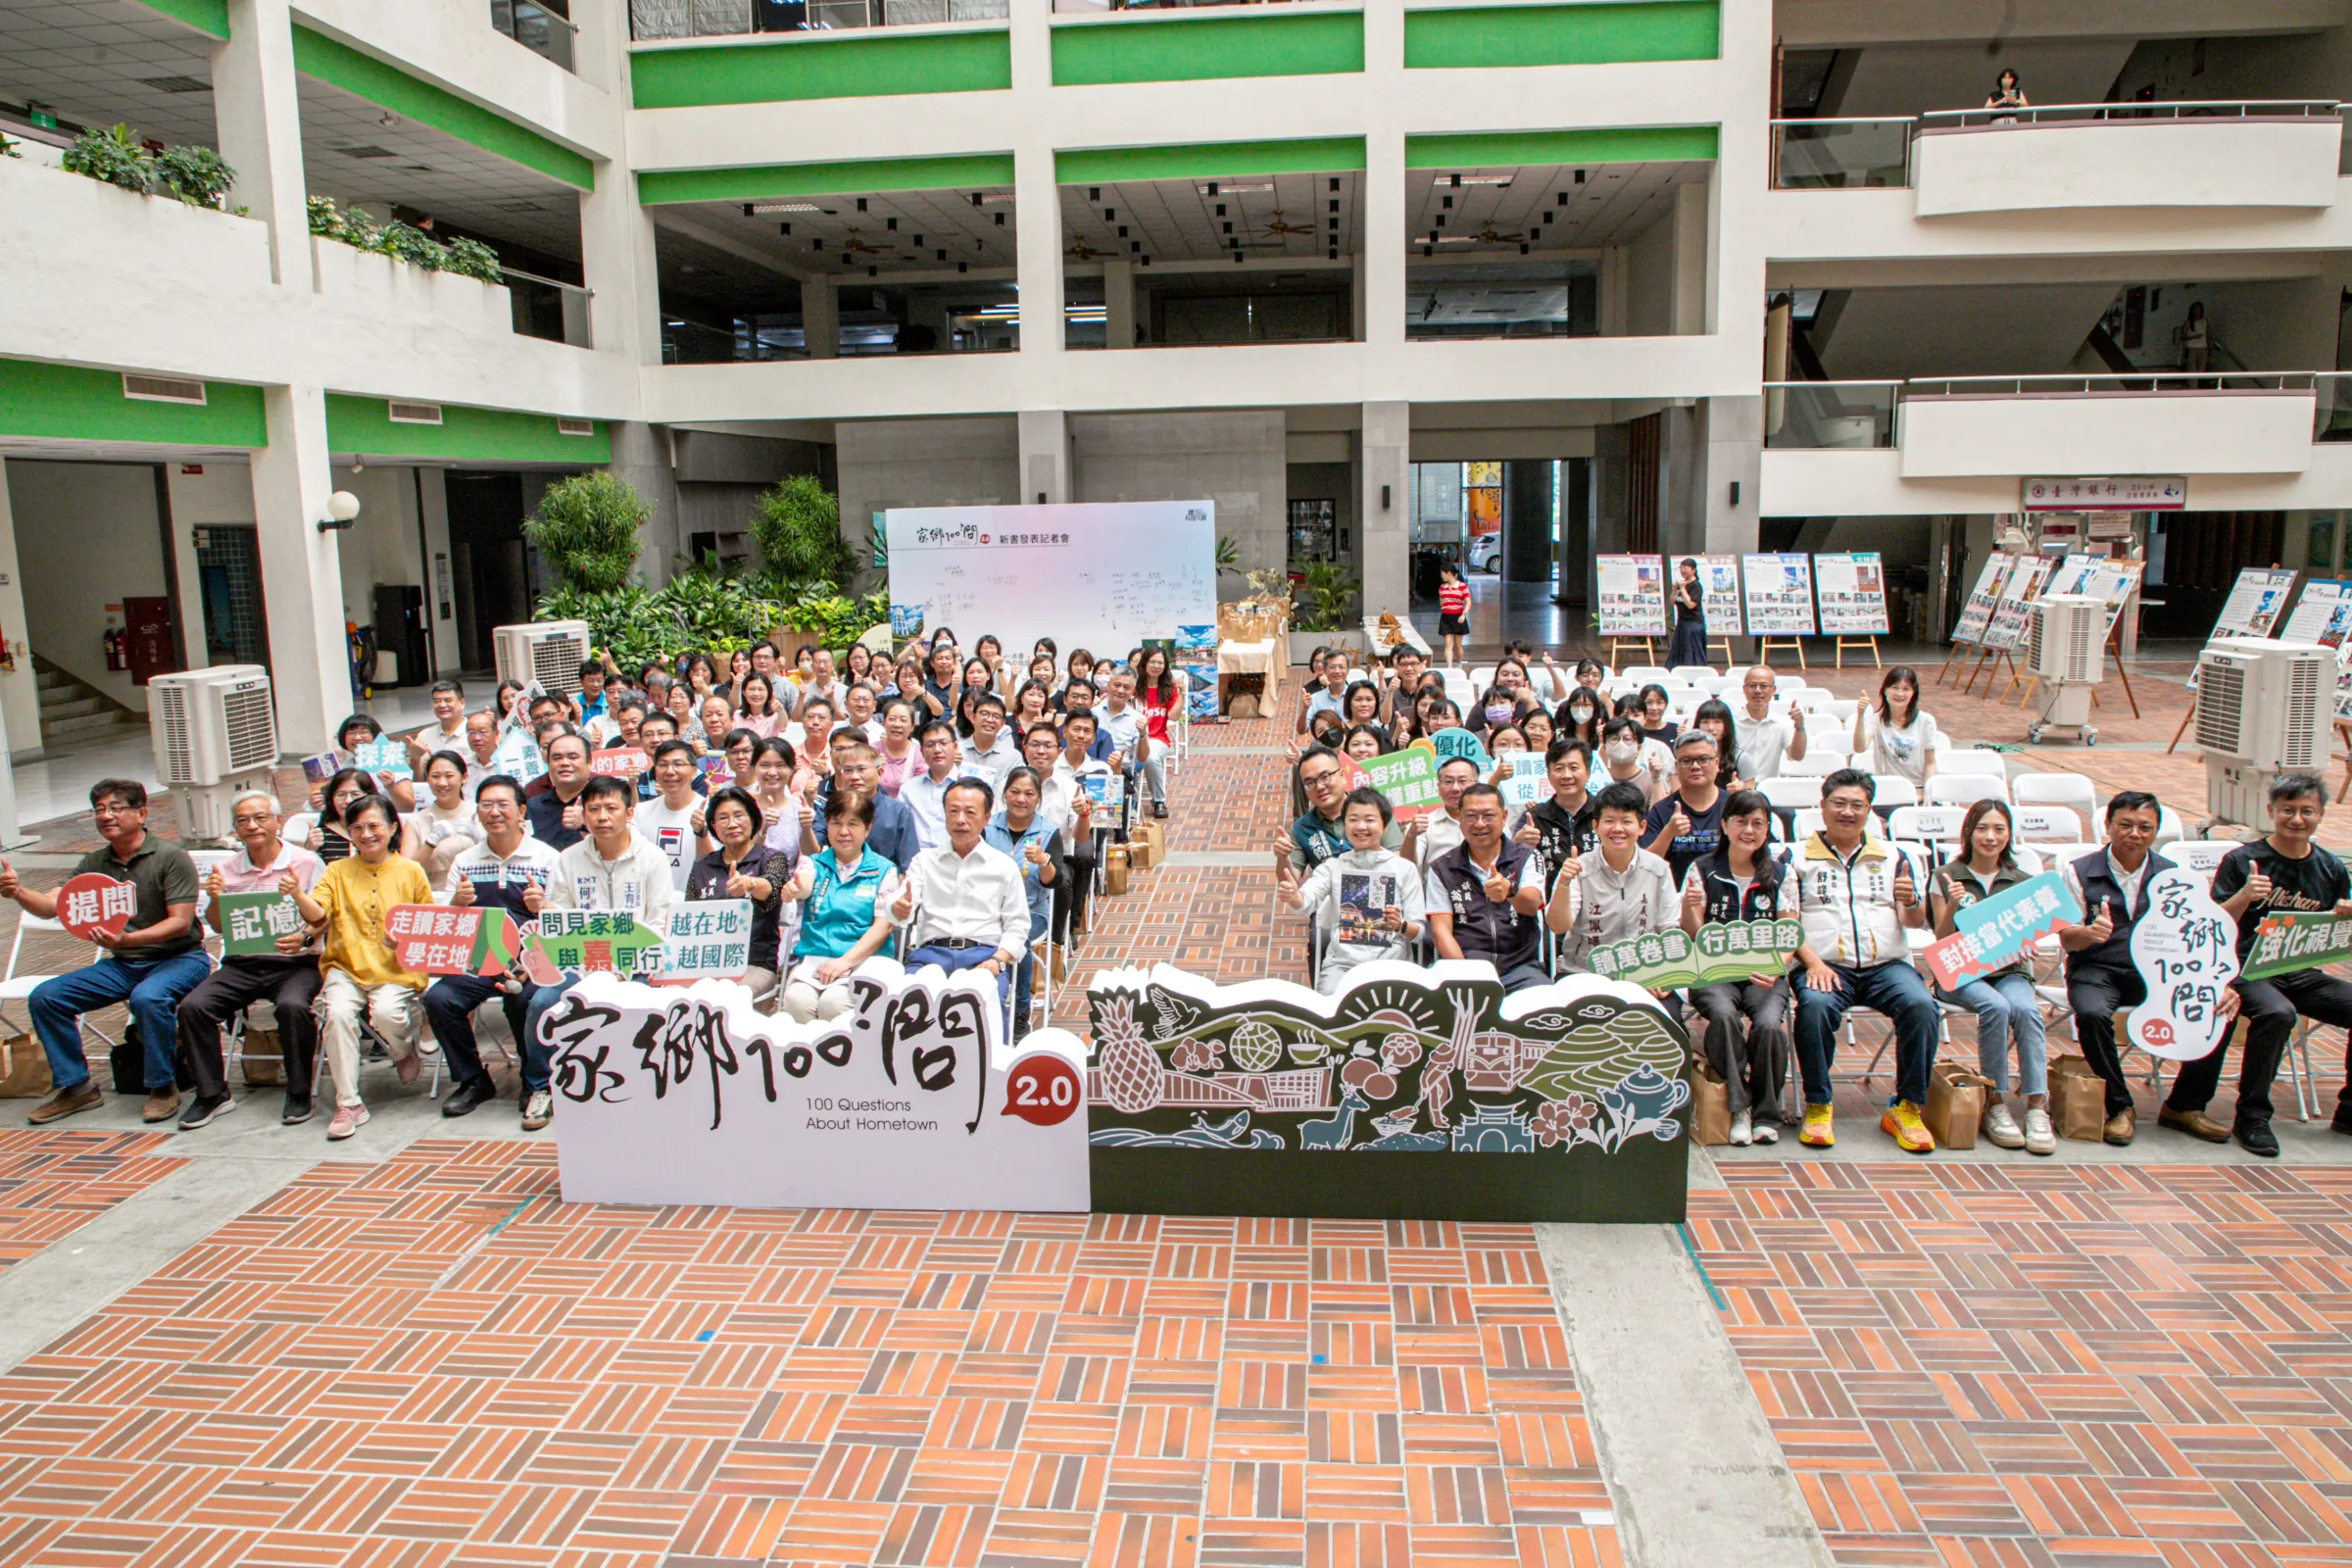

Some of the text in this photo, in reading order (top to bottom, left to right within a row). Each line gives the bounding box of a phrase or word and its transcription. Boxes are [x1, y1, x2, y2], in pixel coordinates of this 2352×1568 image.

[2051, 484, 2118, 497] 臺灣銀行
[999, 533, 1069, 545] 新書發表記者會
[355, 741, 406, 769] 探索
[1435, 735, 1476, 758] 優化
[1352, 756, 1428, 790] 內容升級
[66, 883, 136, 926] 提問
[623, 882, 636, 908] 王育
[2256, 886, 2322, 911] Alishan
[229, 899, 303, 942] 記憶
[391, 909, 479, 938] 走讀家鄉
[542, 911, 634, 937] 問見家鄉
[670, 910, 738, 937] 越在地
[1937, 884, 2062, 975] 對接當代素養
[1702, 924, 1799, 955] 行萬里路
[2256, 919, 2351, 965] 強化視覺
[404, 942, 470, 968] 學在地
[558, 940, 662, 972] 與嘉同行
[677, 943, 745, 970] 越國際
[1591, 934, 1687, 975] 讀萬卷書
[2144, 1025, 2171, 1039] 2.0
[1015, 1076, 1073, 1106] 2.0
[807, 1098, 911, 1112] 100 Questions
[806, 1117, 938, 1131] About Hometown
